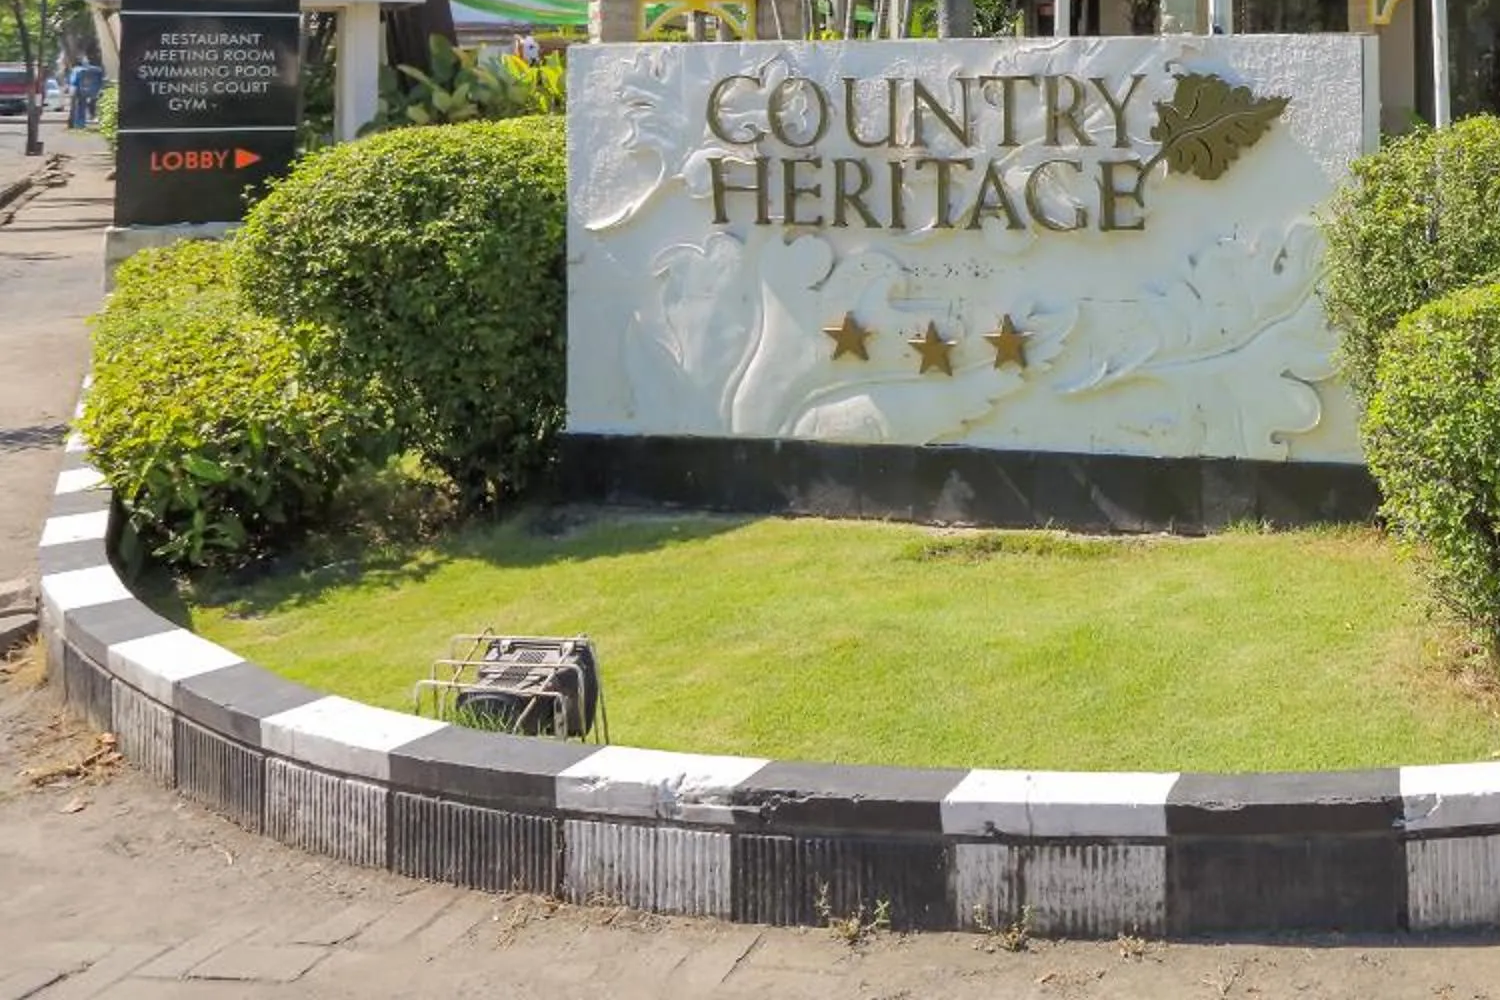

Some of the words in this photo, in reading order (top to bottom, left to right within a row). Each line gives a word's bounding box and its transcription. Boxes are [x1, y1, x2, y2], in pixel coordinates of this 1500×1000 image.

[161, 33, 263, 46] RESTAURANT
[143, 49, 218, 61] MEETING
[223, 49, 275, 61] ROOM
[138, 65, 230, 78] SWIMMING
[235, 65, 280, 77] POOL
[149, 81, 208, 94] TENNIS
[213, 81, 270, 94] COURT
[168, 98, 207, 111] GYM
[706, 73, 1148, 149] COUNTRY
[151, 151, 229, 171] LOBBY
[706, 155, 1147, 231] HERITAGE
